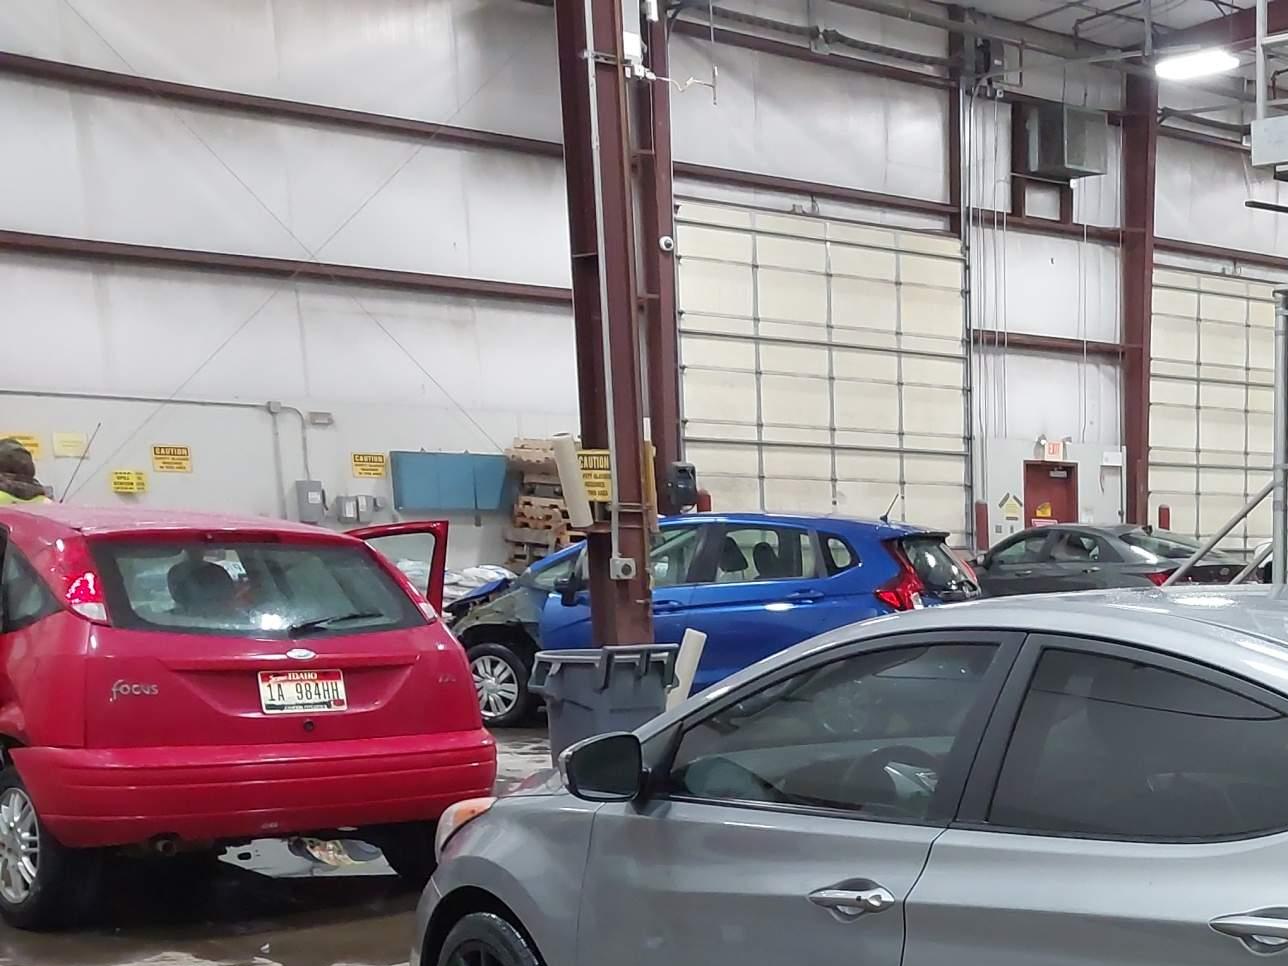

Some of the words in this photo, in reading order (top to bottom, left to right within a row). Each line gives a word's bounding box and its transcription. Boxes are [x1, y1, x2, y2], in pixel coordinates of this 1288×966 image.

[288, 672, 318, 680] IDAHO
[267, 683, 285, 702] 1A
[295, 681, 340, 701] 984HH
